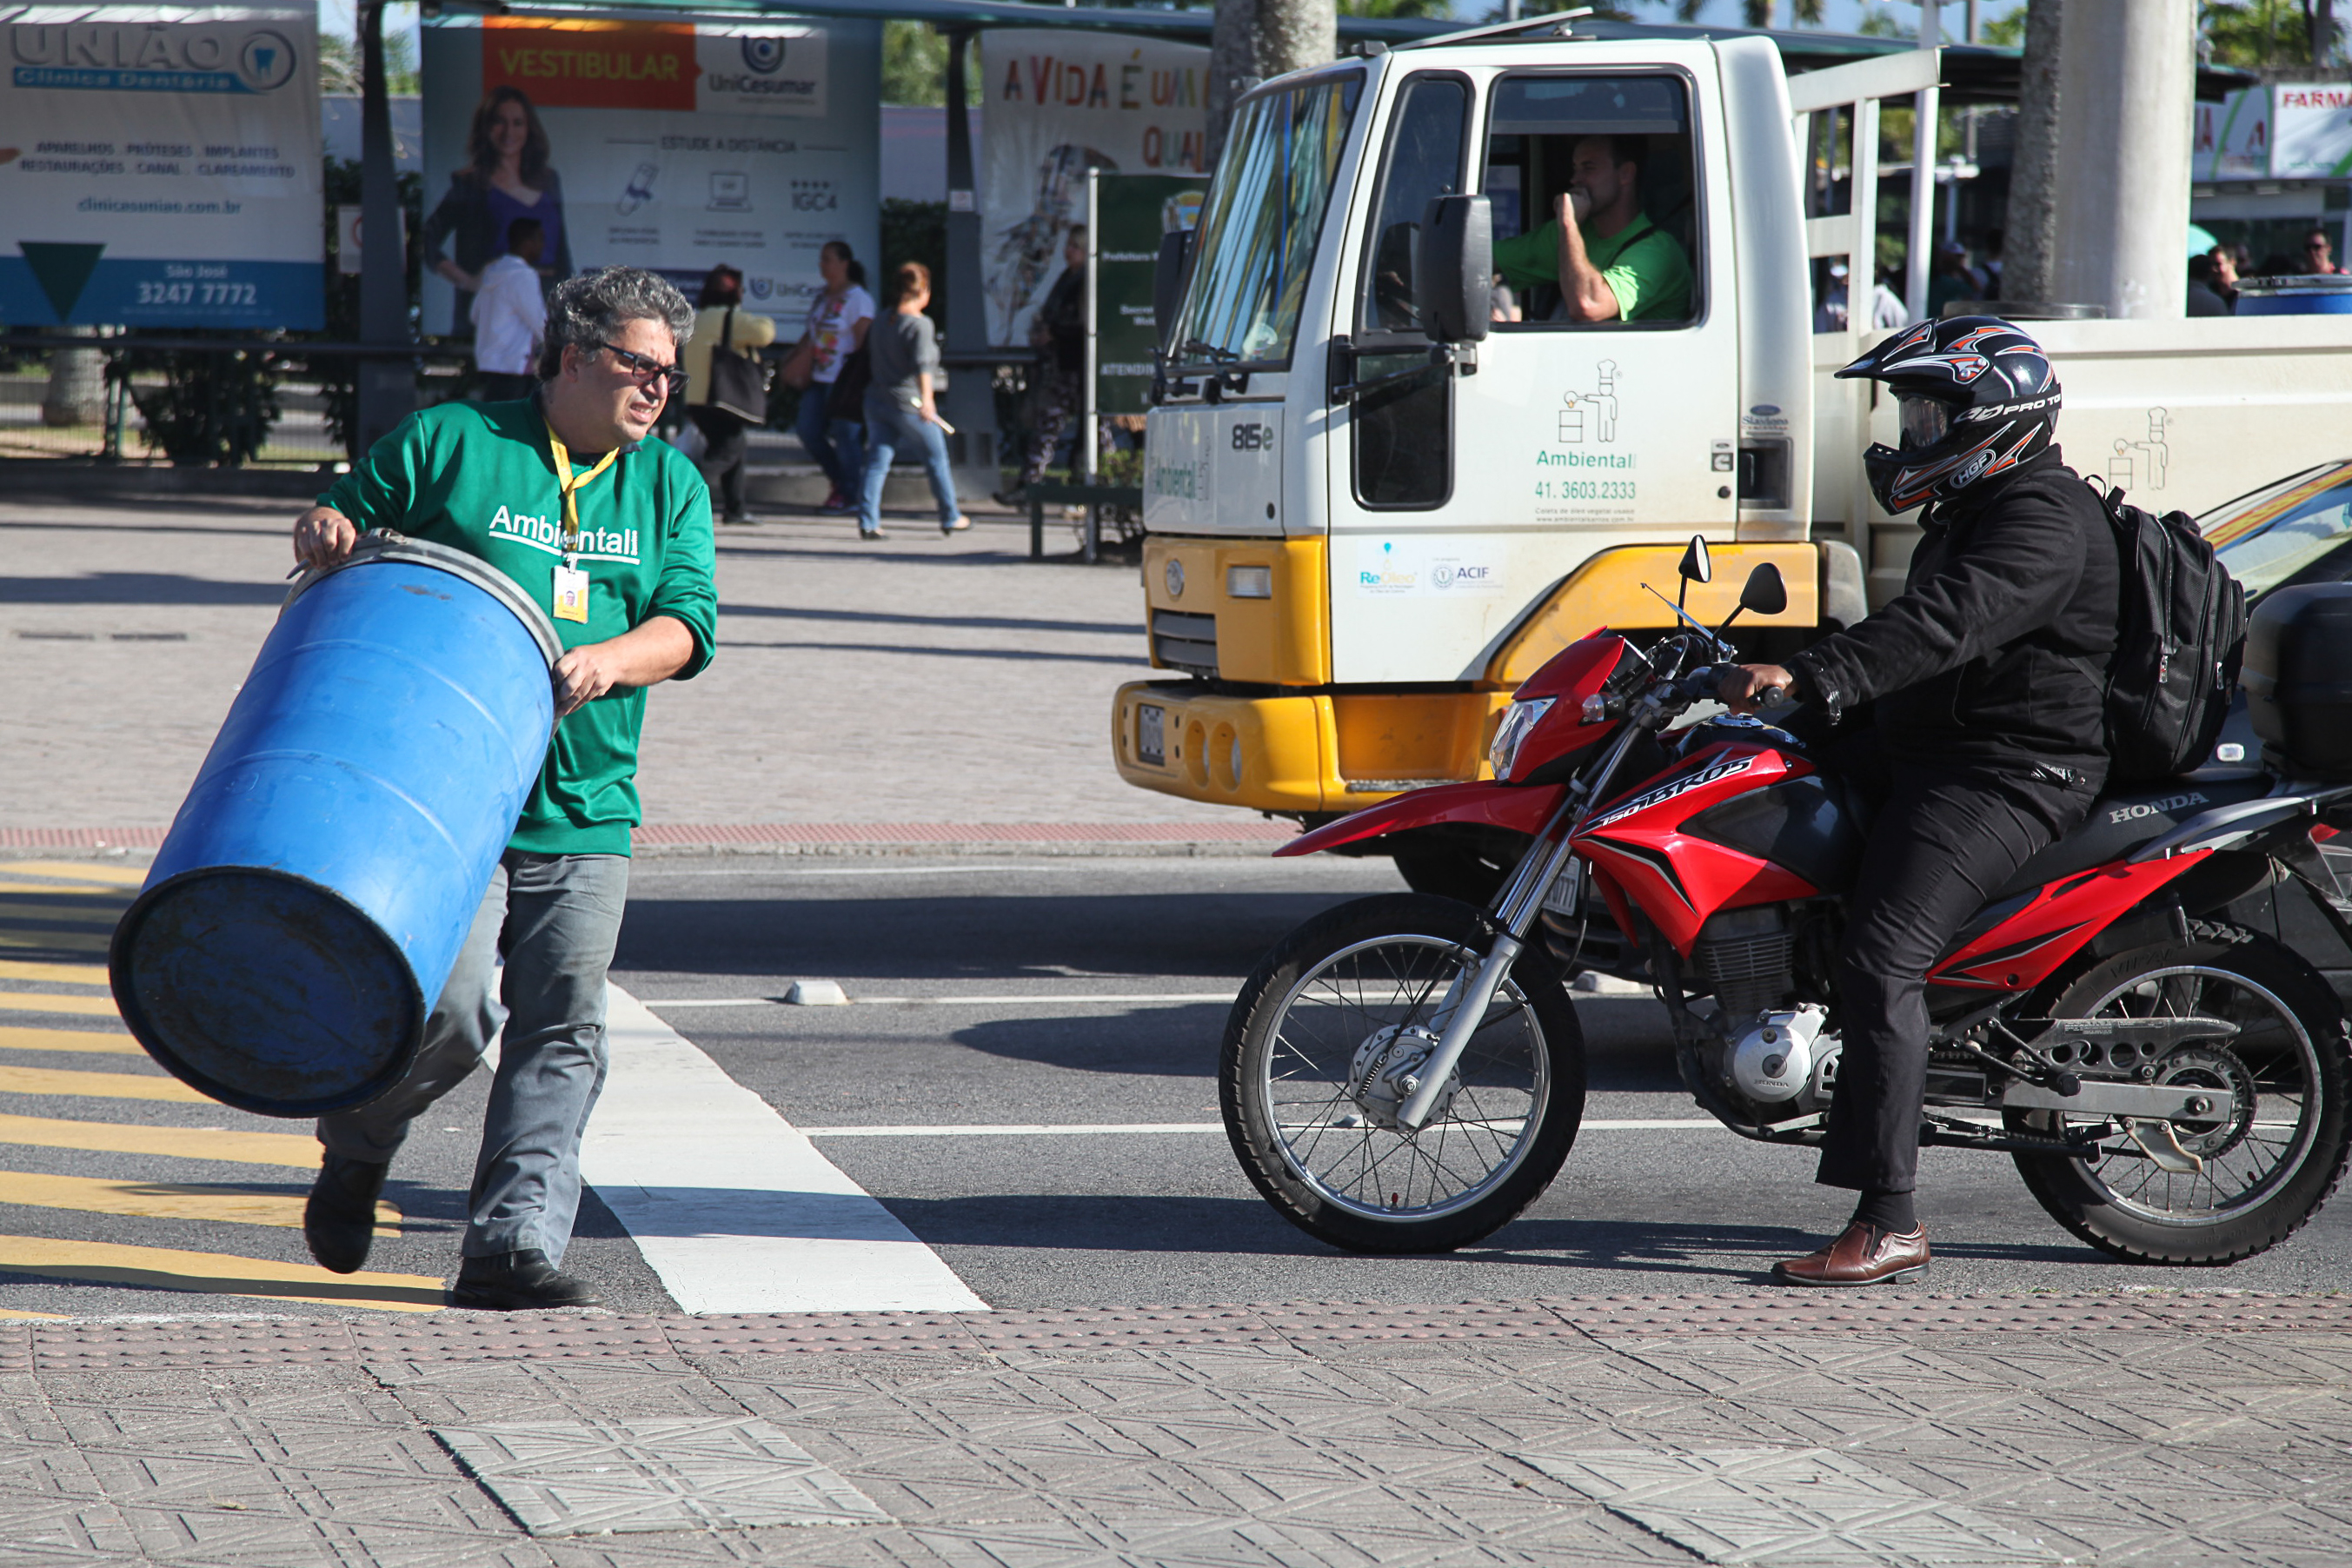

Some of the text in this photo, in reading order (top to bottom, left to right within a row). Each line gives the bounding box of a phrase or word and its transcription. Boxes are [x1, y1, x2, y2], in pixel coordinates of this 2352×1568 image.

[10, 23, 226, 71] UNIÃO
[500, 47, 679, 81] VESTIBULAR
[709, 73, 817, 96] UniCesumar
[1004, 60, 1023, 101] A
[1030, 56, 1109, 108] VIDA
[1120, 48, 1143, 110] É
[37, 142, 279, 159] APARELHOS PRÓTESES IMPLANTES
[661, 136, 710, 150] ESTUDE
[21, 158, 296, 178] RESTAURAÇÕES CANAL CLAREAMENTO
[77, 196, 242, 214] clinicasuniao.com.br
[792, 193, 838, 211] IGC4
[166, 264, 228, 278] São José
[137, 282, 257, 305] 3247 7772
[2003, 399, 2046, 415] PRO
[1536, 450, 1631, 469] Ambiental
[1957, 454, 1988, 484] HGF
[1562, 481, 1636, 499] 3603.2333
[1457, 567, 1489, 580] ACIF
[1632, 759, 1754, 809] BROS
[1599, 804, 1640, 826] 150
[2109, 792, 2209, 824] HONDA
[1754, 1079, 1789, 1088] HONDA
